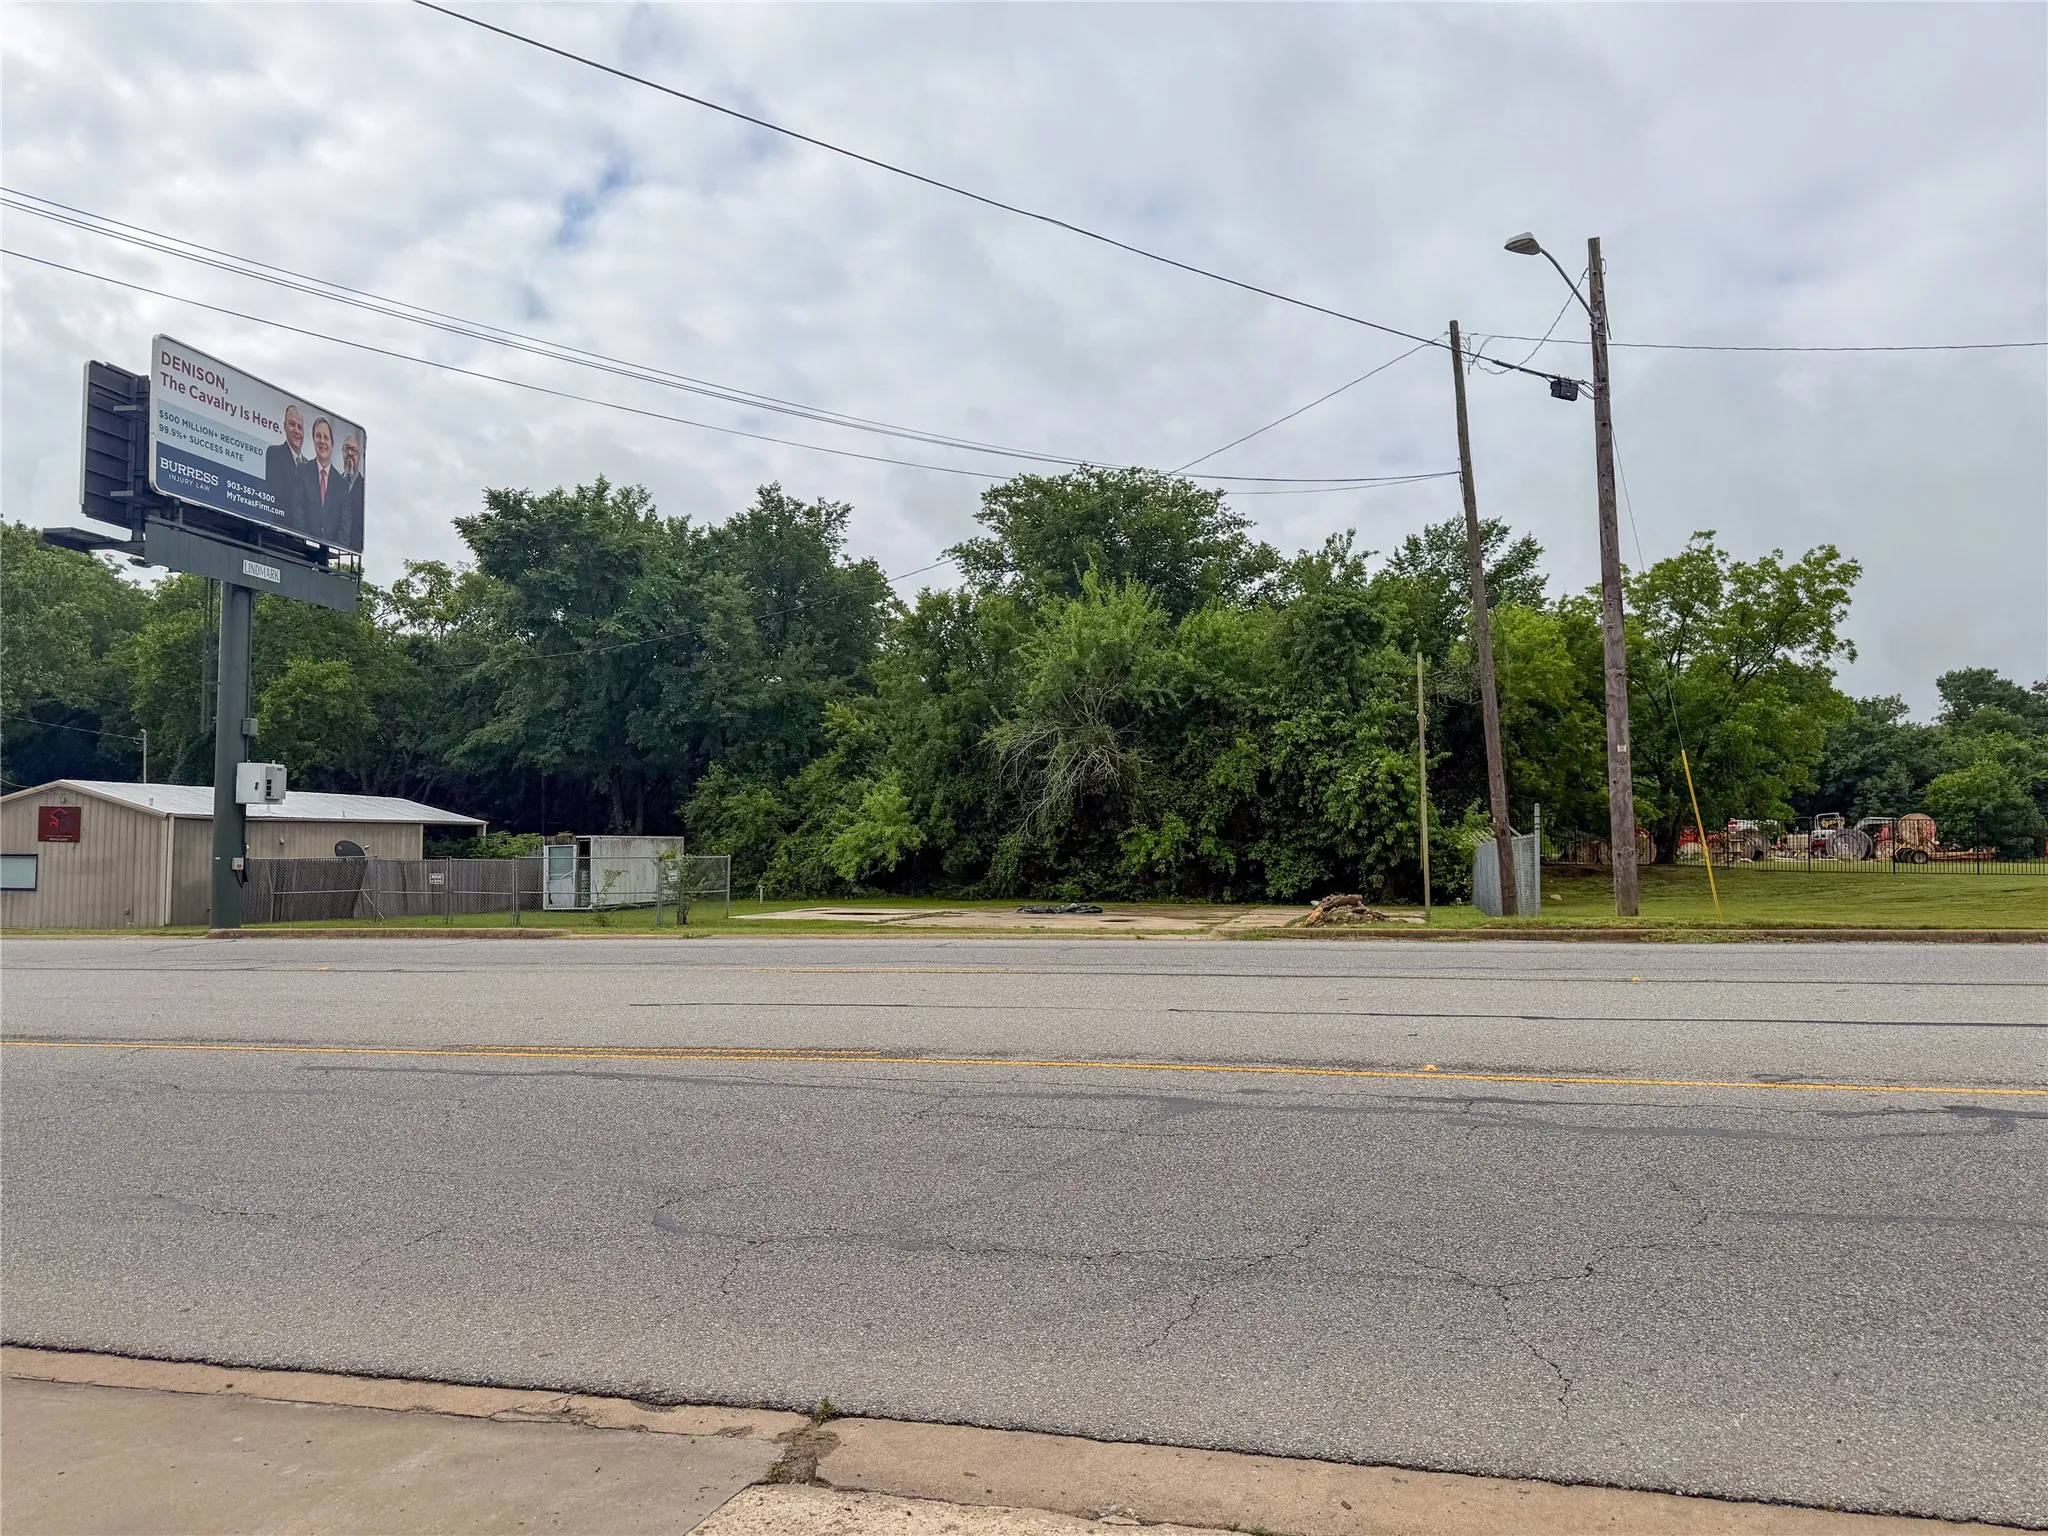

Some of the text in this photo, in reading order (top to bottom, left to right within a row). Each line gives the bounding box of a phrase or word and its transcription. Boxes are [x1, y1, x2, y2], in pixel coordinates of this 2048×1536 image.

[161, 351, 229, 394] DENISON,
[160, 371, 282, 434] The Cavalry Is Here.
[159, 409, 263, 456] $500 MILLION+ RECOVERED
[159, 424, 244, 462] 99.9%+ SUCCESS RATE
[160, 457, 219, 486] BURRESS
[168, 473, 210, 492] INJURY LAW
[226, 479, 275, 503] 903-367-4300
[226, 490, 285, 517] MyTexasFirm.com
[244, 561, 279, 581] LINDMARK
